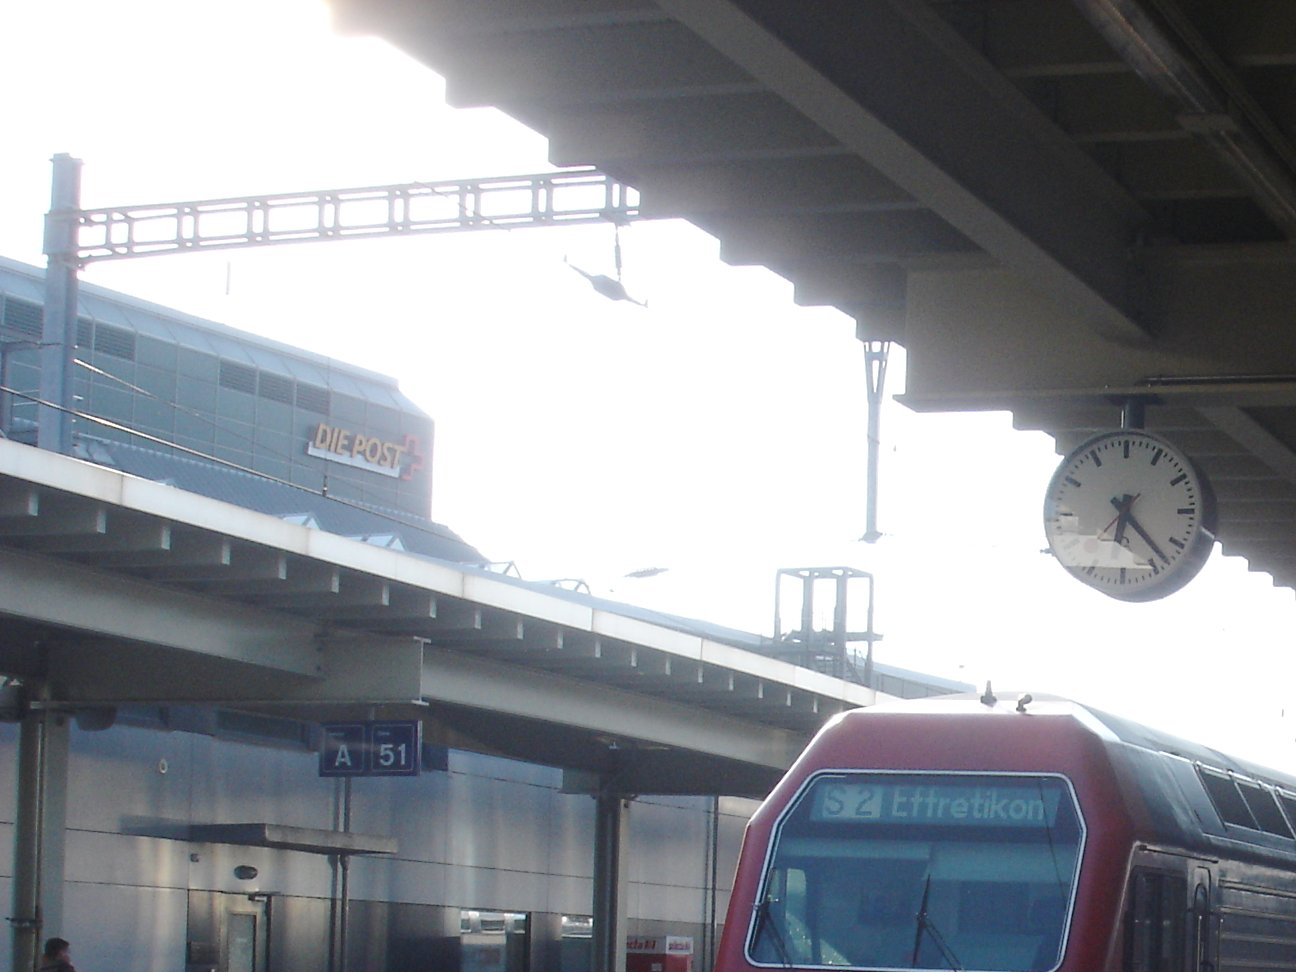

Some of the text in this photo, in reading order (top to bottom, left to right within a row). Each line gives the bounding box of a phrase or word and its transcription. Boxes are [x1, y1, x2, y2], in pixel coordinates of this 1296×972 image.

[315, 423, 407, 469] DIE POST
[335, 743, 406, 766] A 51
[892, 785, 1045, 821] Effretikon
